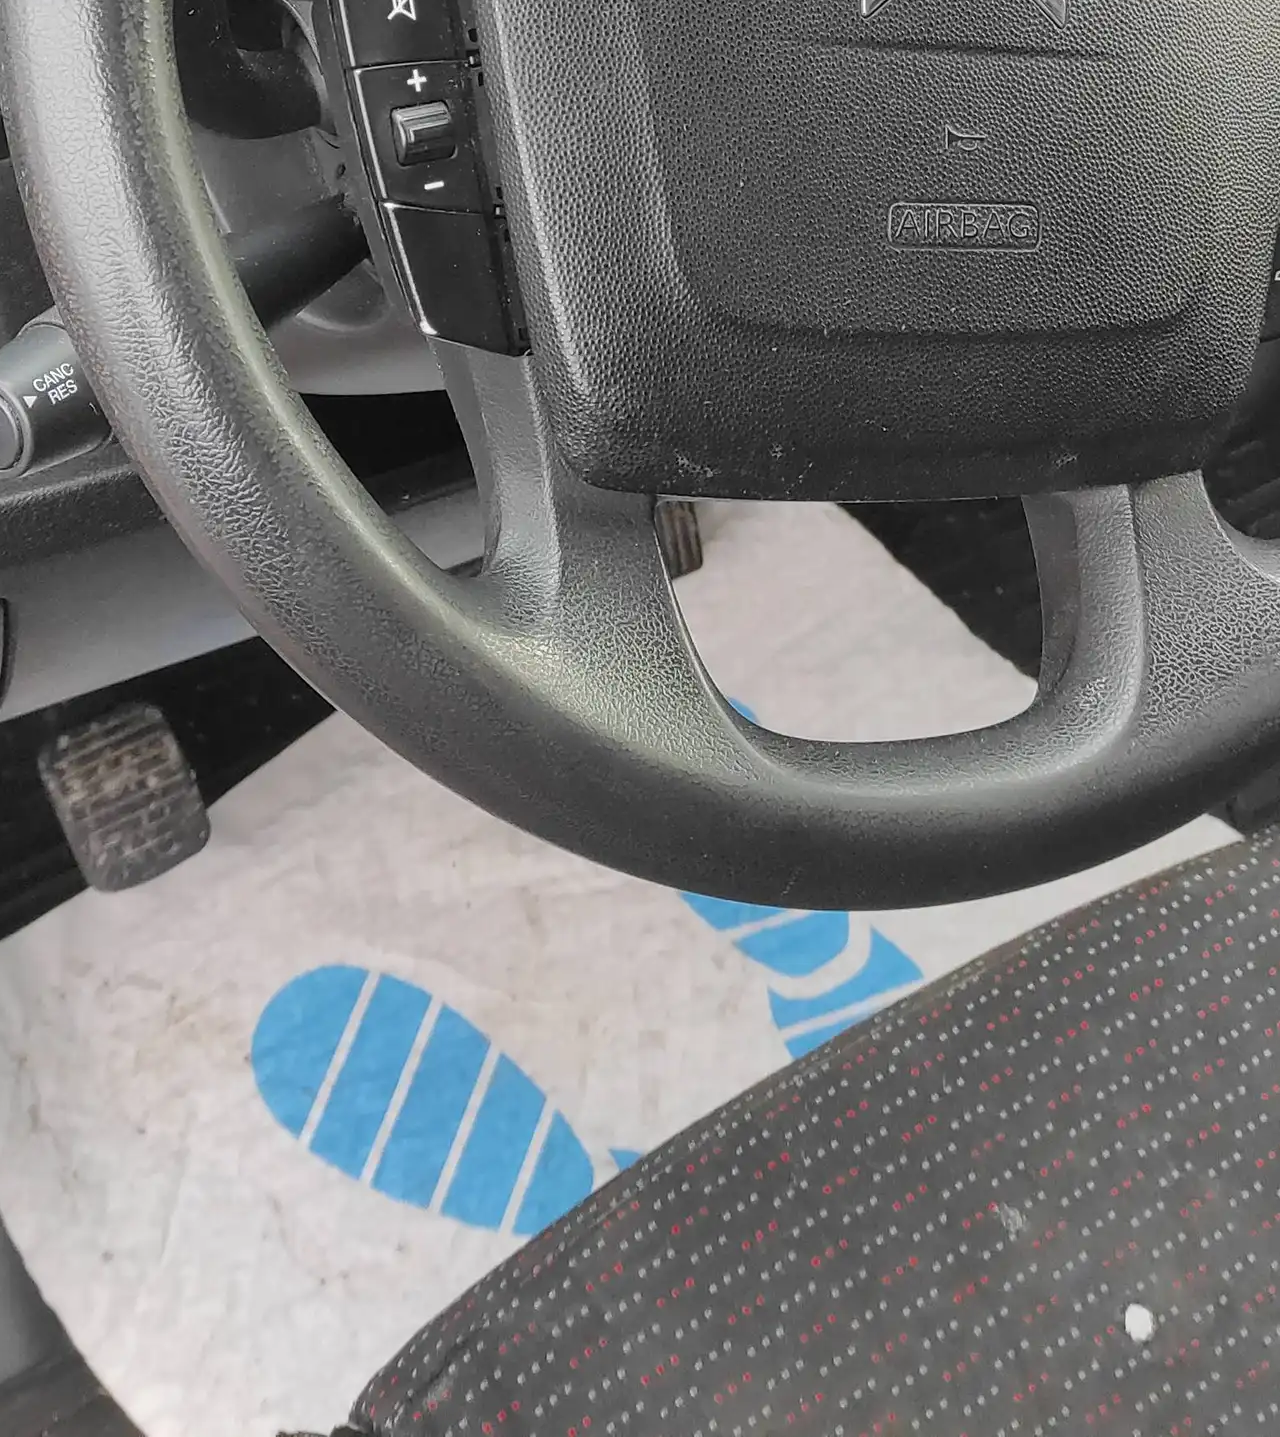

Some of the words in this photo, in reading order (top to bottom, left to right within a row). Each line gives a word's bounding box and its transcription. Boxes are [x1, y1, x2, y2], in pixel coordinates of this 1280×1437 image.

[894, 209, 1030, 240] AIRBAG
[32, 362, 75, 392] CANC
[47, 379, 78, 405] RES
